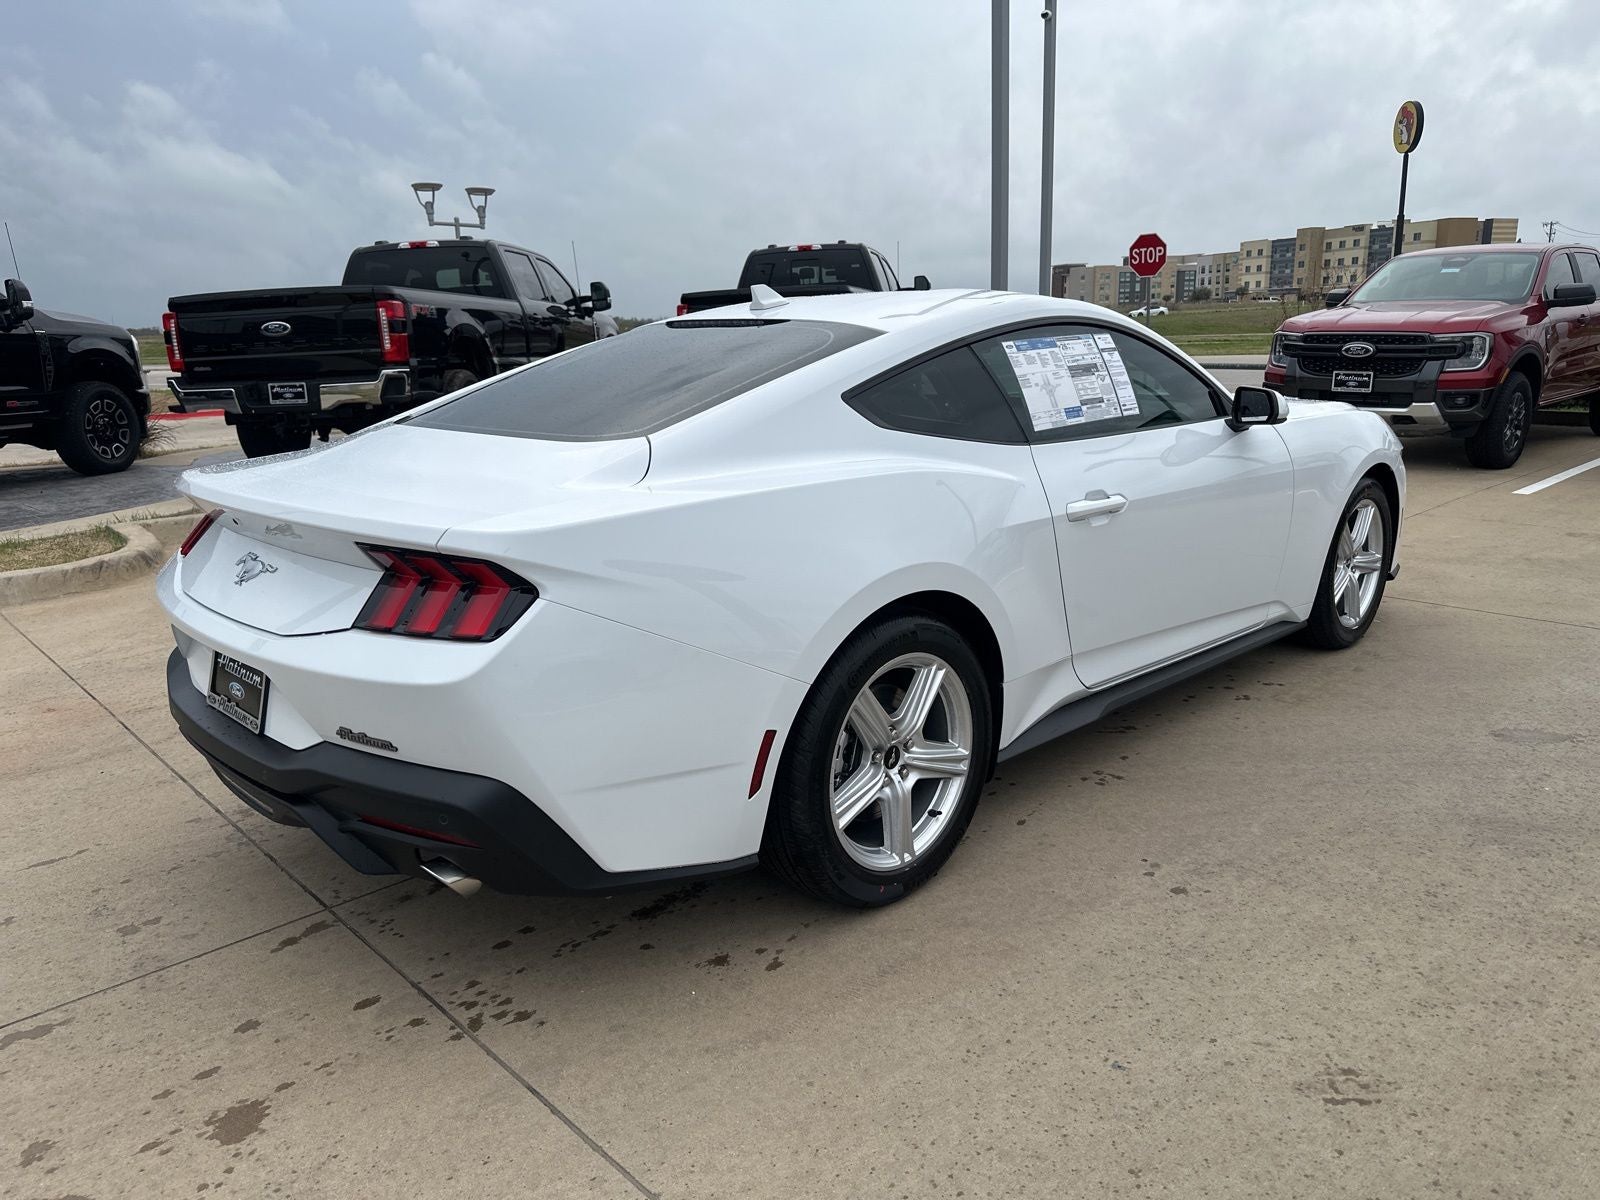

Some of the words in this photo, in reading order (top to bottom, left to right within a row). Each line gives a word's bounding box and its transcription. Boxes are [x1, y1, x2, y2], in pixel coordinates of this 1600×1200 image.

[1131, 246, 1165, 265] STOP
[218, 653, 262, 689] Platinum
[218, 696, 251, 726] Platinum
[336, 726, 398, 752] Platinum
